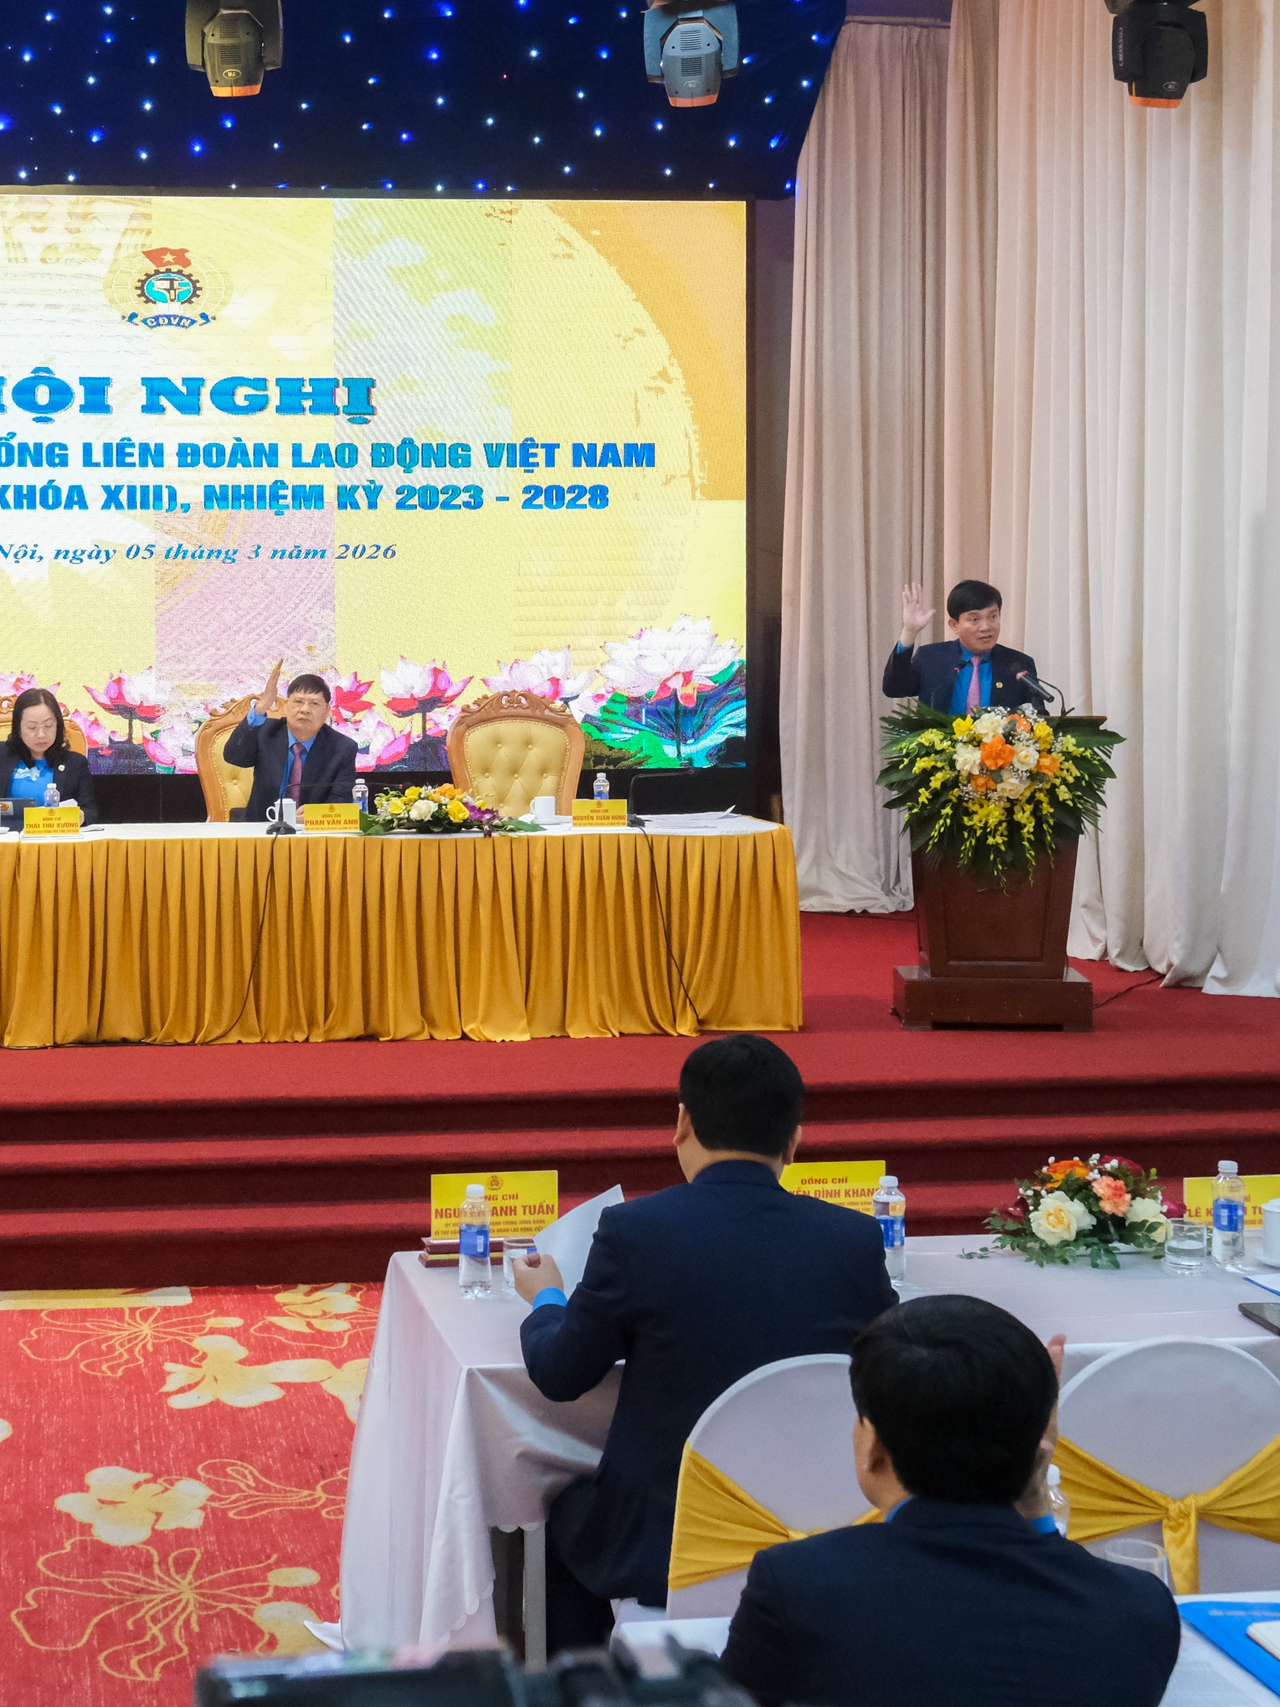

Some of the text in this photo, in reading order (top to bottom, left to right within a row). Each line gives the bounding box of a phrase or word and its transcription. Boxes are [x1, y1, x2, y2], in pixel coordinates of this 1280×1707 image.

[141, 376, 376, 425] NGHỊ
[82, 437, 164, 469] LIÊN
[176, 437, 278, 469] ĐOÀN
[292, 442, 358, 469] LAO
[370, 438, 472, 474] ĐỘNG
[484, 437, 560, 473] VIỆT
[572, 442, 656, 468] NAM
[101, 483, 191, 514] XIII),
[204, 480, 324, 516] NHIỆM
[337, 480, 383, 511] KỲ
[396, 484, 483, 511] 2023
[522, 484, 610, 510] 2028
[53, 544, 117, 565] ngày
[125, 543, 156, 560] 05
[163, 543, 239, 564] tháng
[247, 543, 262, 560] 3
[270, 544, 327, 560] năm
[335, 543, 397, 560] 2026
[831, 1176, 848, 1184] CHÍ
[502, 1193, 518, 1201] CHÍ
[814, 1187, 841, 1199] ĐÌNH
[491, 1205, 517, 1217] ANH
[521, 1200, 555, 1216] TUẤN
